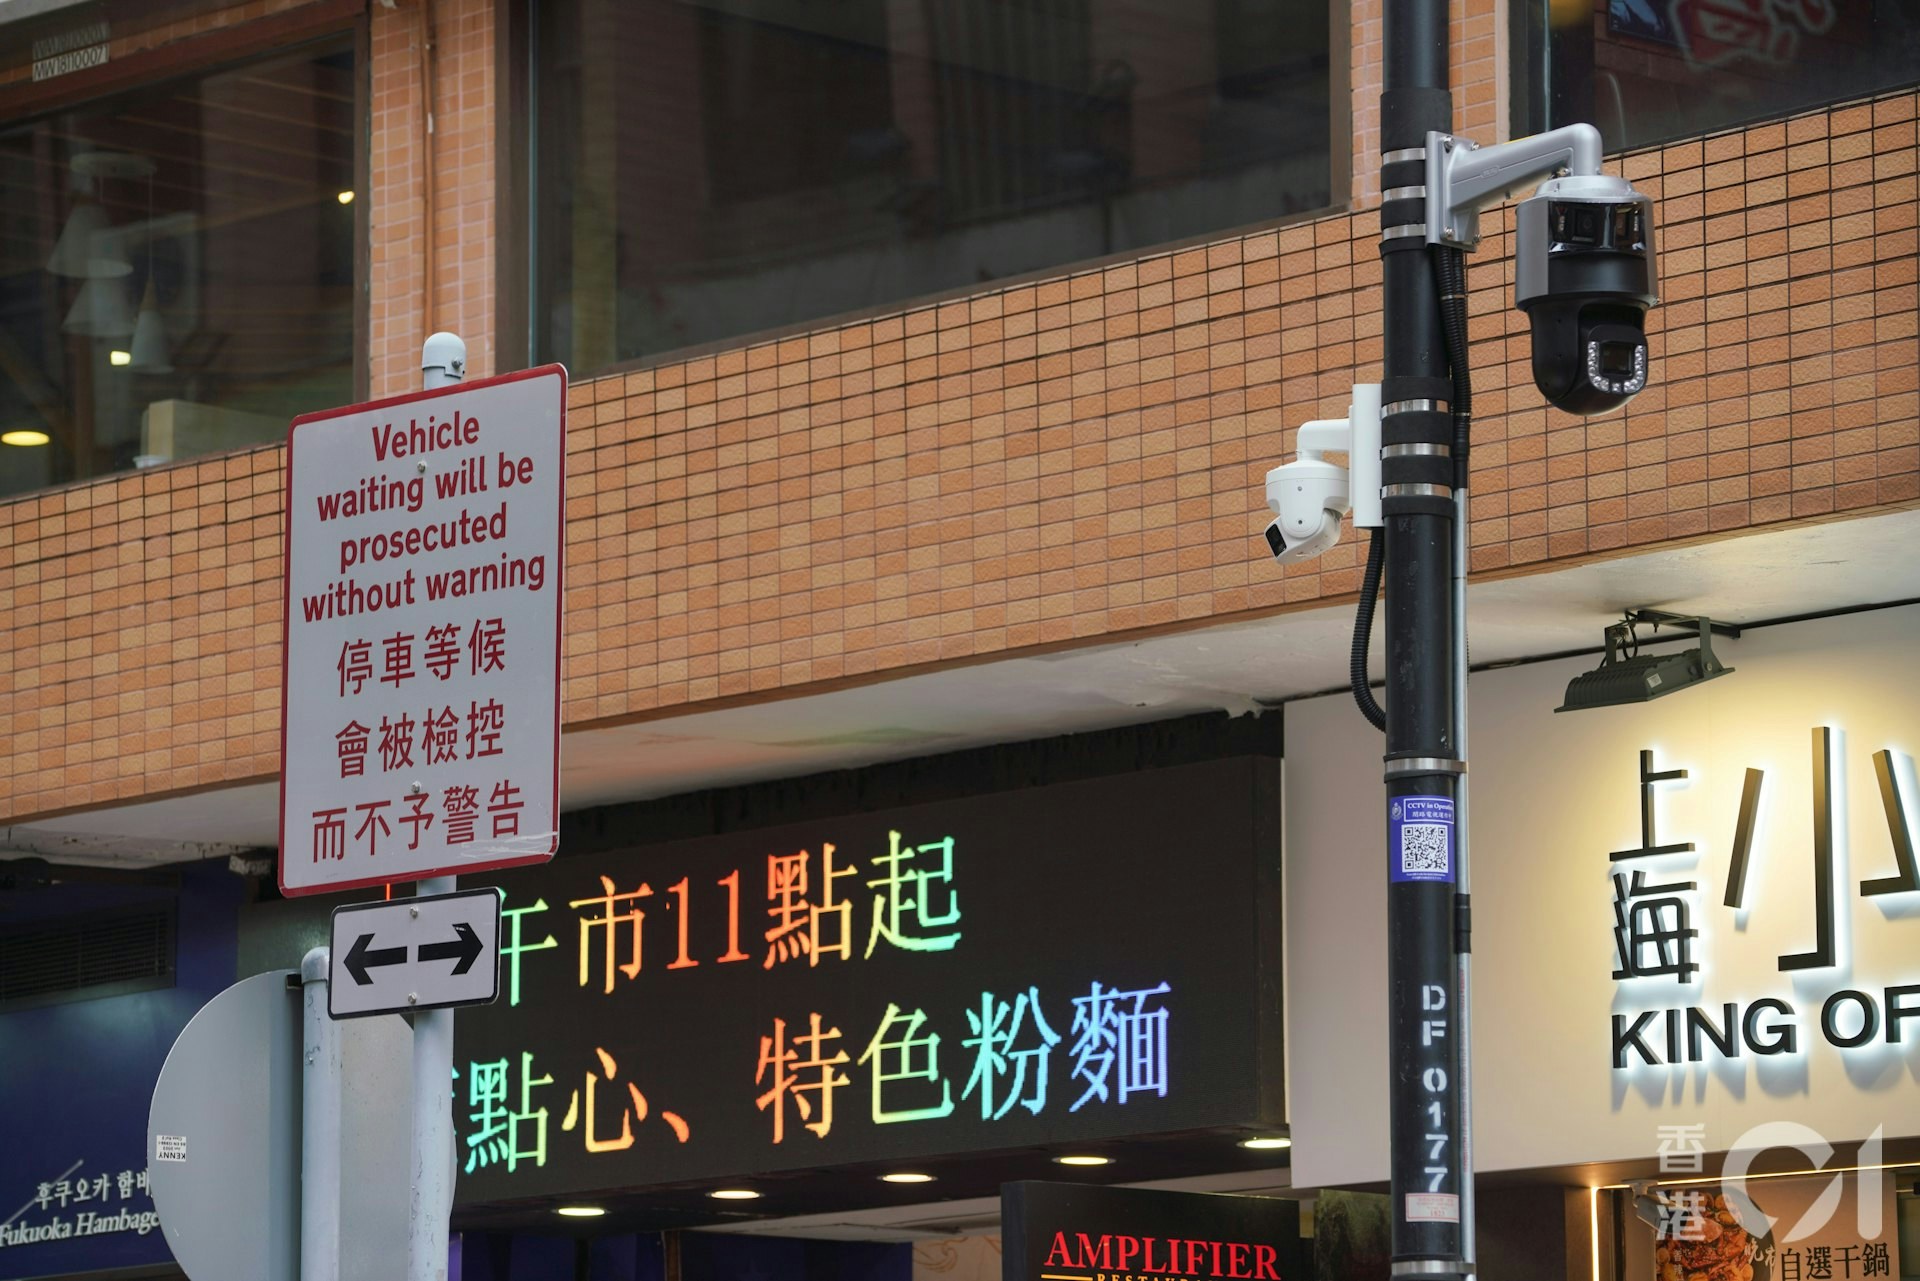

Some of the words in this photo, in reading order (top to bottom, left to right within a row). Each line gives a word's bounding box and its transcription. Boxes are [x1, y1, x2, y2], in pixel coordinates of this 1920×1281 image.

[372, 411, 480, 461] Vehicle
[318, 473, 424, 521] waiting
[435, 457, 487, 500] will
[498, 452, 534, 488] be
[340, 502, 507, 574] prosecuted
[303, 570, 415, 622] without
[426, 554, 545, 604] warning
[337, 616, 506, 698] 停車等候
[335, 698, 505, 779] 會被檢控
[312, 780, 525, 864] 而不予警告
[1609, 749, 1699, 984] 上海
[1612, 997, 1797, 1069] KING
[1821, 985, 1920, 1049] OF
[452, 980, 1172, 1175] 點心、特色粉麵
[158, 1151, 186, 1160] KENNY
[1422, 1067, 1449, 1193] 0177
[35, 1173, 111, 1210] 후쿠오카
[0, 1216, 71, 1248] Fukuoka
[1044, 1231, 1281, 1281] AMPLIFIER
